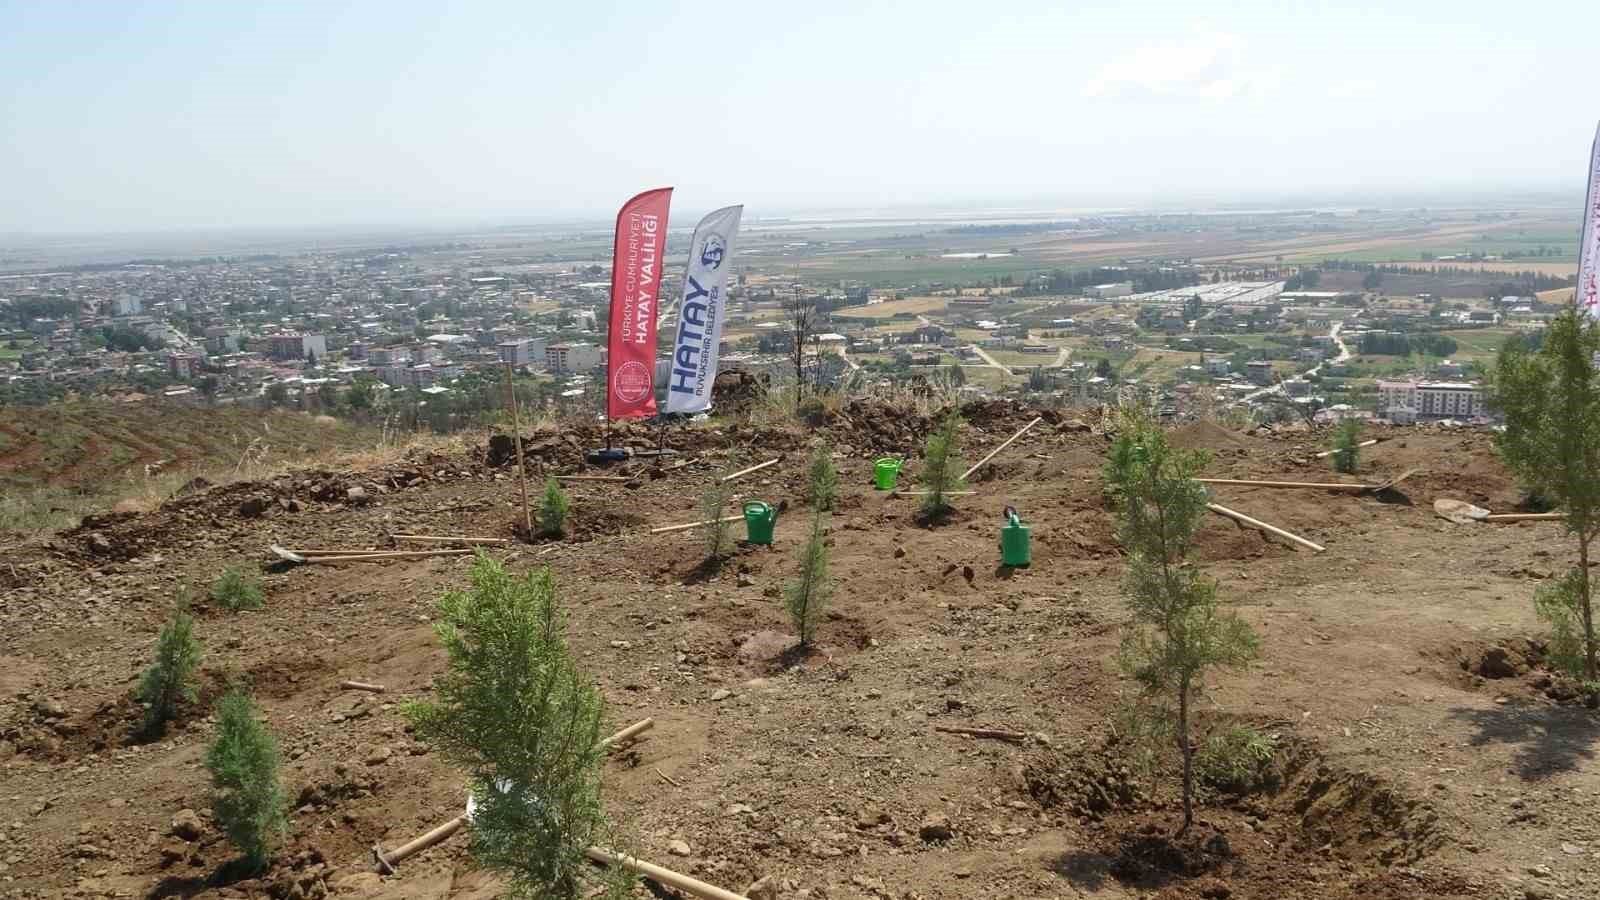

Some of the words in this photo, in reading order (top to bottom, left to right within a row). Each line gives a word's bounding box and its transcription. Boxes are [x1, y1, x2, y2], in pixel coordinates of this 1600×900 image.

[626, 212, 642, 291] CUMHURİYETİ
[641, 214, 658, 287] VALİLİĞİ
[622, 294, 635, 343] TÜRKİYE
[635, 293, 652, 344] HATAY
[671, 276, 709, 394] HATAY
